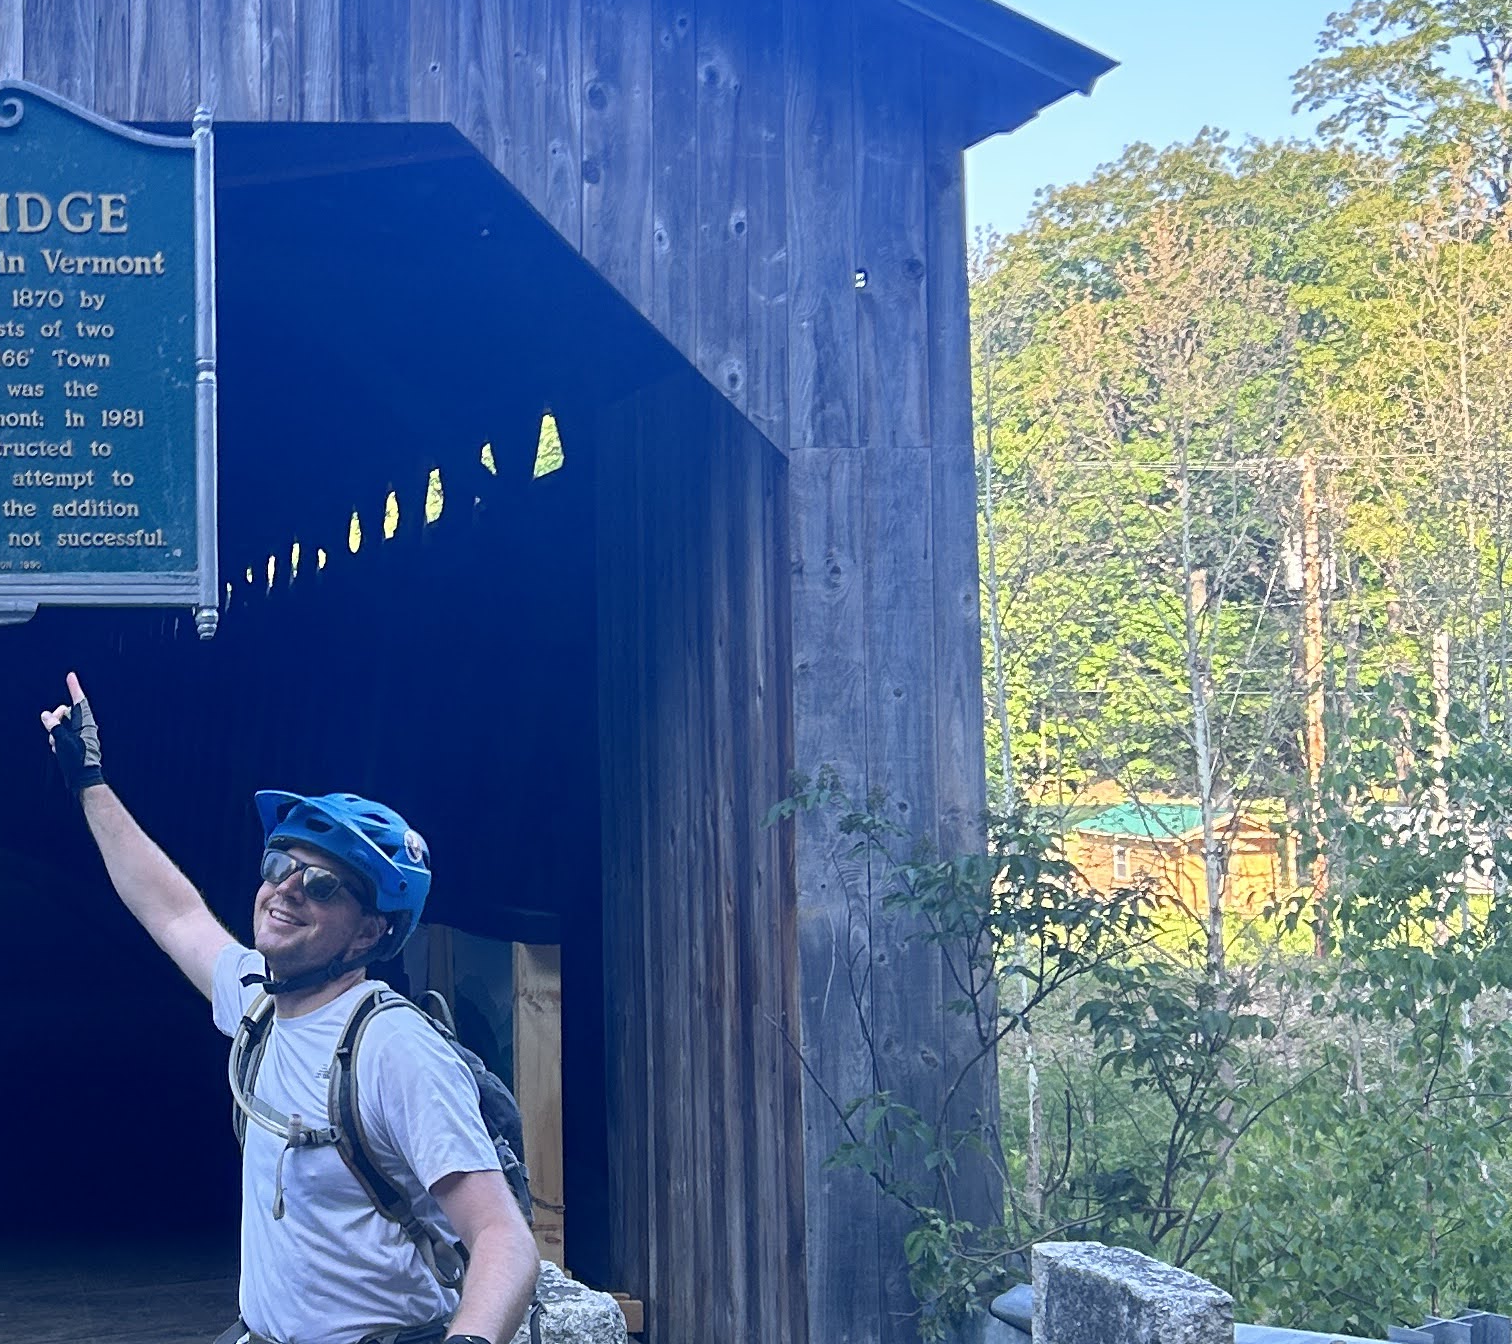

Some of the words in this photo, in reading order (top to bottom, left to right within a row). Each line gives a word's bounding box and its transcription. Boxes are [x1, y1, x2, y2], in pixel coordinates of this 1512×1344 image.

[40, 248, 166, 276] Vermont
[12, 287, 64, 308] 1870
[79, 290, 106, 311] by
[40, 320, 63, 338] of
[76, 321, 115, 339] two
[51, 348, 111, 368] Town
[7, 383, 45, 398] was
[64, 380, 99, 398] the
[65, 409, 86, 427] in
[101, 408, 144, 428] 1981
[89, 440, 112, 457] to
[12, 469, 95, 490] attempt
[112, 470, 135, 487] to
[3, 499, 37, 517] the
[52, 499, 139, 517] addition
[8, 531, 42, 548] not
[57, 528, 168, 548] successful.
